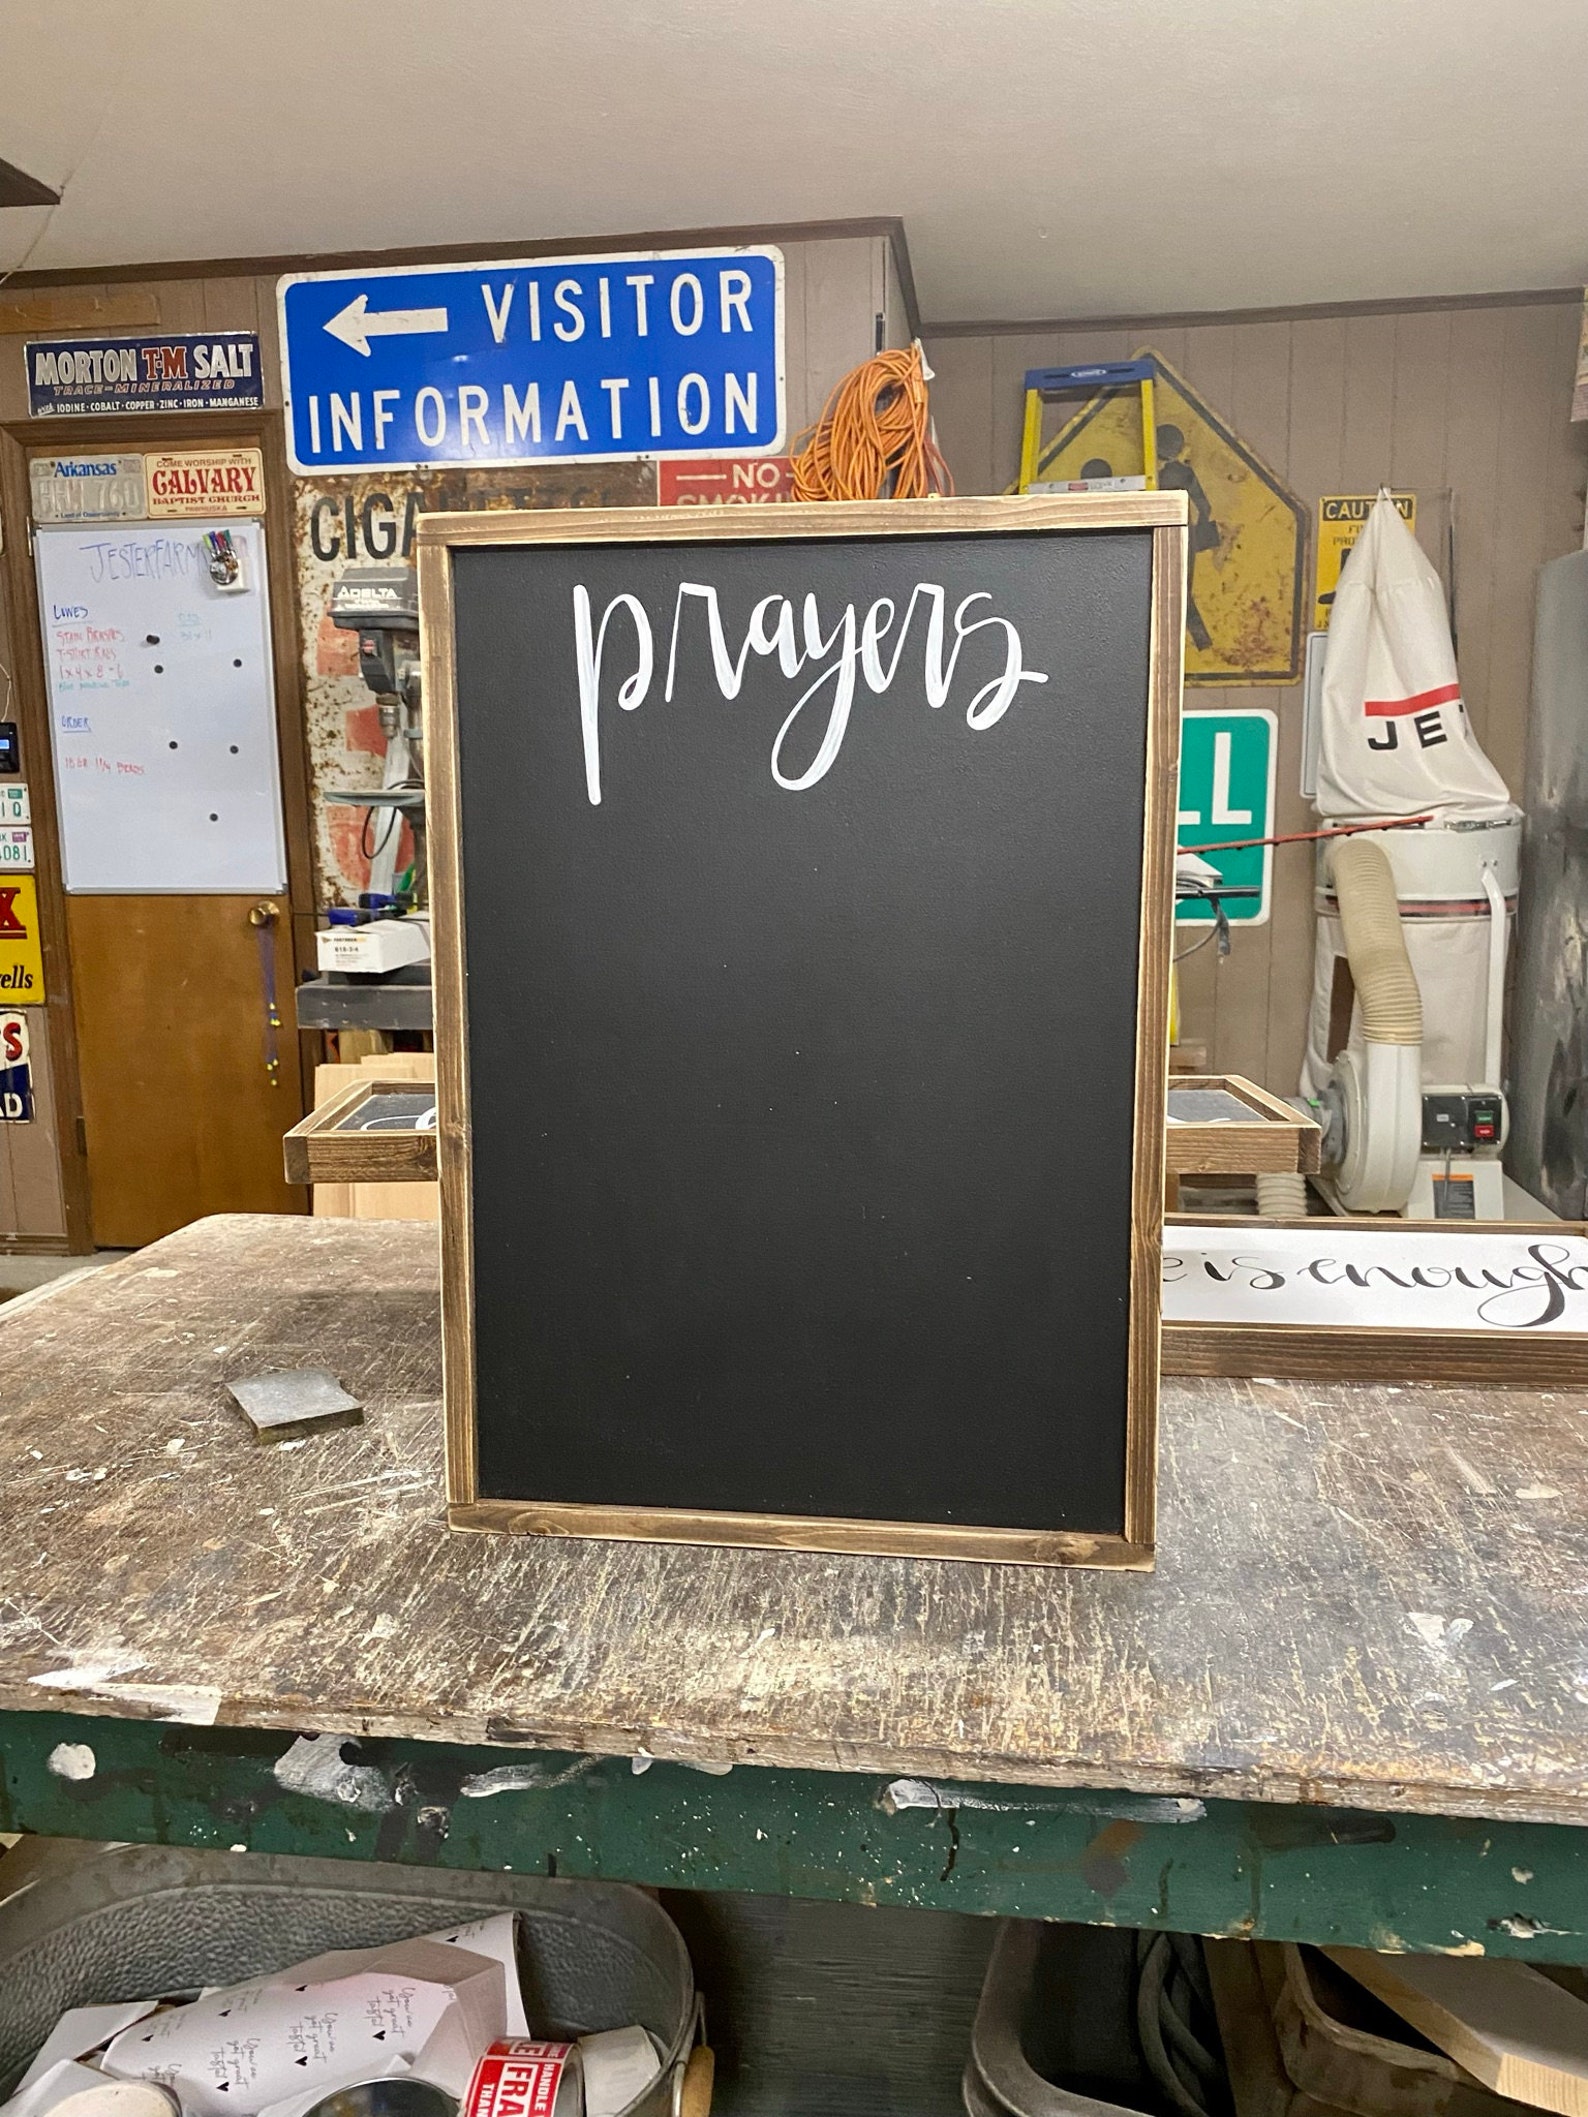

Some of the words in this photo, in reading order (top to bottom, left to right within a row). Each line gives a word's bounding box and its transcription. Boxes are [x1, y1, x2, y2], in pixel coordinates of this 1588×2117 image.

[481, 270, 753, 343] VISITOR
[35, 349, 137, 385] MORTON
[193, 344, 253, 378] SALT
[53, 378, 235, 396] TRACE-MINERALIZED
[57, 403, 85, 413] IODINE
[90, 401, 120, 412] COBALT
[125, 400, 154, 410] COPPER
[160, 399, 178, 409] ZINC
[183, 398, 204, 408] IRON
[209, 397, 258, 407] MANGANESE
[309, 373, 757, 453] INFORMATION
[55, 462, 116, 477] Arkansas
[157, 460, 182, 468] COME
[184, 459, 226, 467] WORSHIP
[732, 463, 780, 489] NO
[152, 467, 256, 495] CALVARY
[153, 496, 205, 505] BAPTIST
[209, 495, 260, 503] CHURCH
[1326, 501, 1409, 519] CAUTN
[573, 582, 1049, 805] prayers
[1368, 705, 1465, 750] JE
[0, 845, 27, 861] 081
[0, 965, 33, 989] ells
[1201, 1252, 1287, 1290] is
[1297, 1243, 1588, 1328] enough
[535, 2063, 555, 2111] HANDLE
